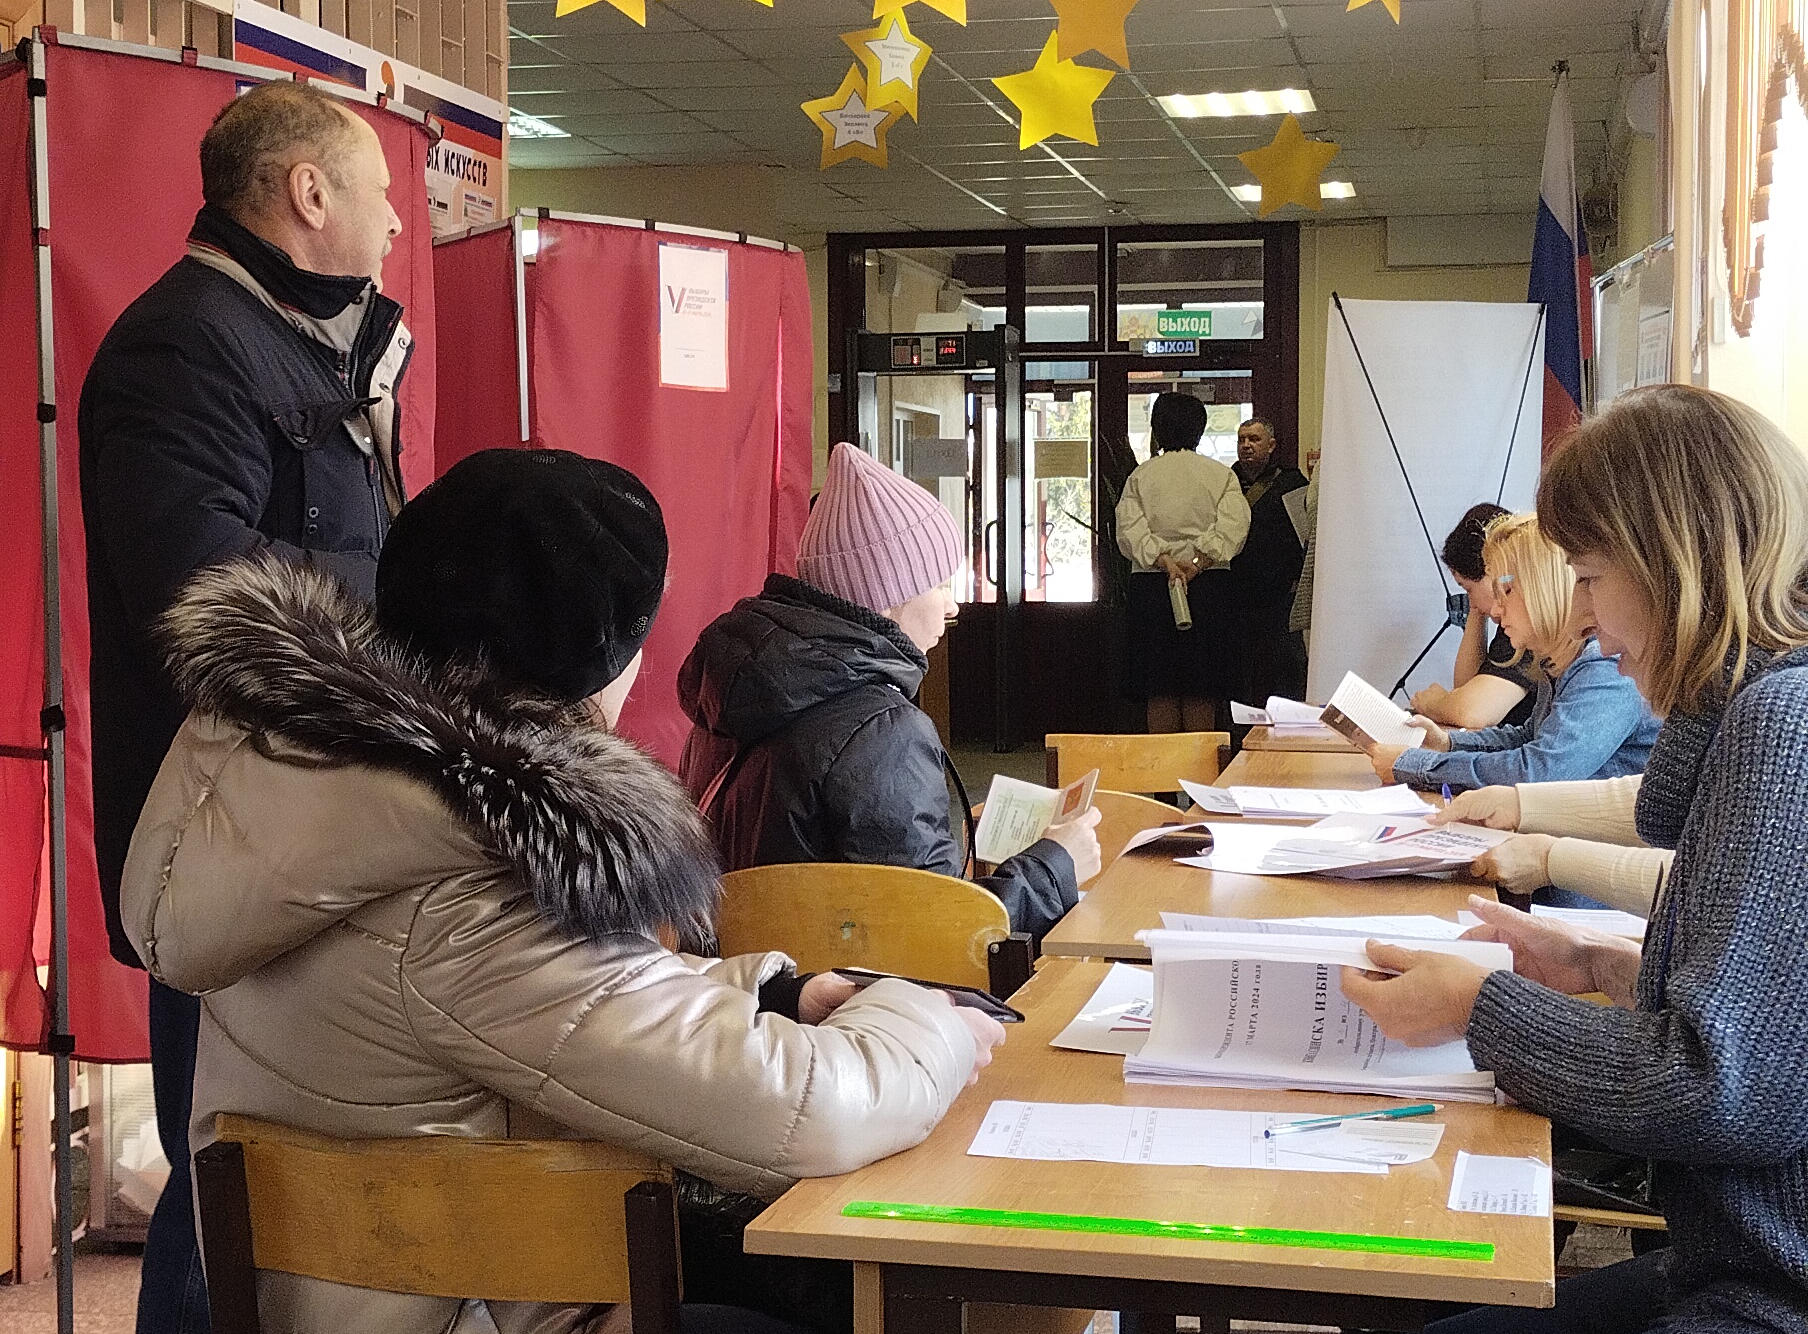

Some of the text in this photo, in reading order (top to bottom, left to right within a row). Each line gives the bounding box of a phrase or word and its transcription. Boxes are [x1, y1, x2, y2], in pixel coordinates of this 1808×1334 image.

[443, 148, 488, 187] ИСКУССТВ
[1159, 316, 1210, 335] ВЫХОД
[1147, 340, 1195, 354] ВЫХОД
[1227, 959, 1240, 1021] РОССИЙСКО
[1251, 987, 1261, 1010] 2024
[1314, 963, 1328, 1012] ИЗБИР
[1247, 1012, 1259, 1041] МАРТА
